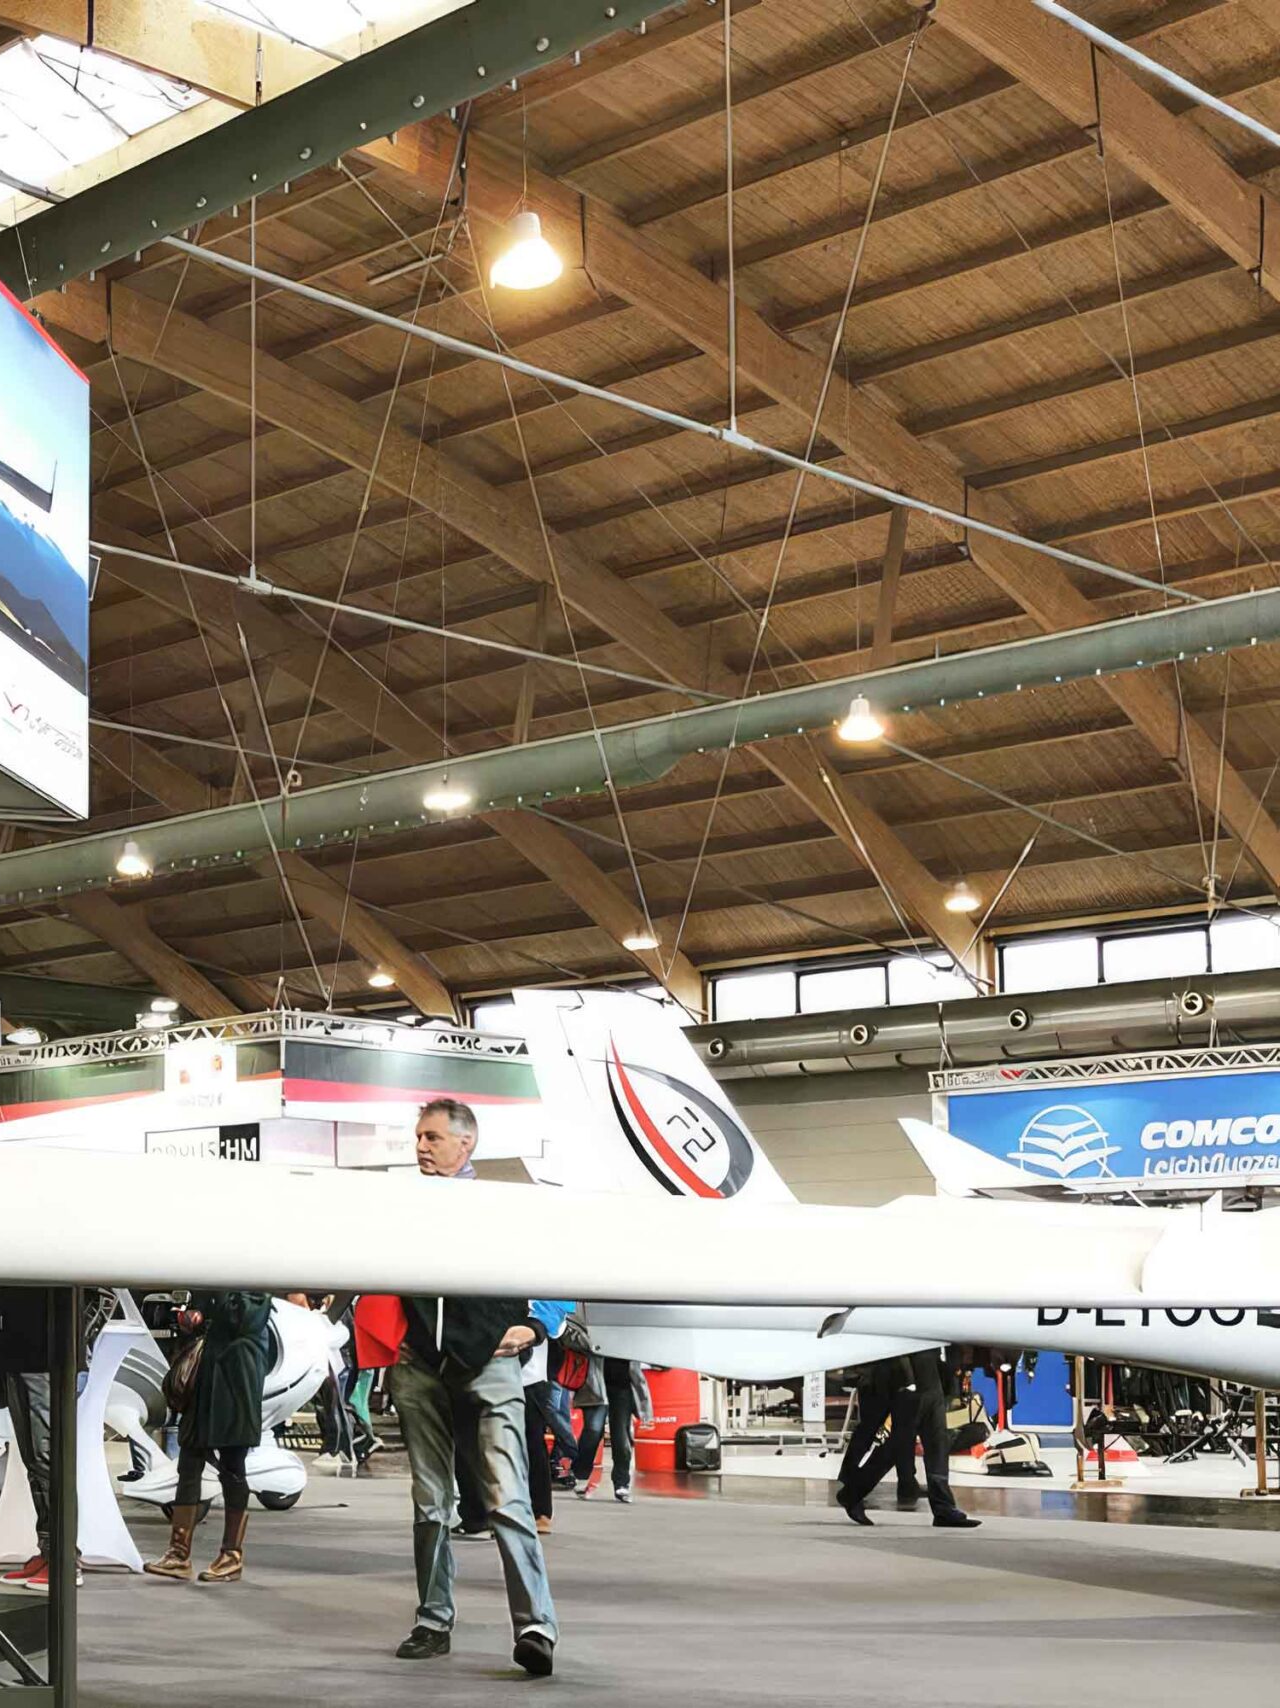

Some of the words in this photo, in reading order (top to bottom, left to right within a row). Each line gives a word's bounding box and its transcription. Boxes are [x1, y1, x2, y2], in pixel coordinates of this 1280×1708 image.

[666, 1106, 716, 1163] F2
[1140, 1114, 1280, 1150] COMCO
[1143, 1152, 1280, 1178] Leichtflugze
